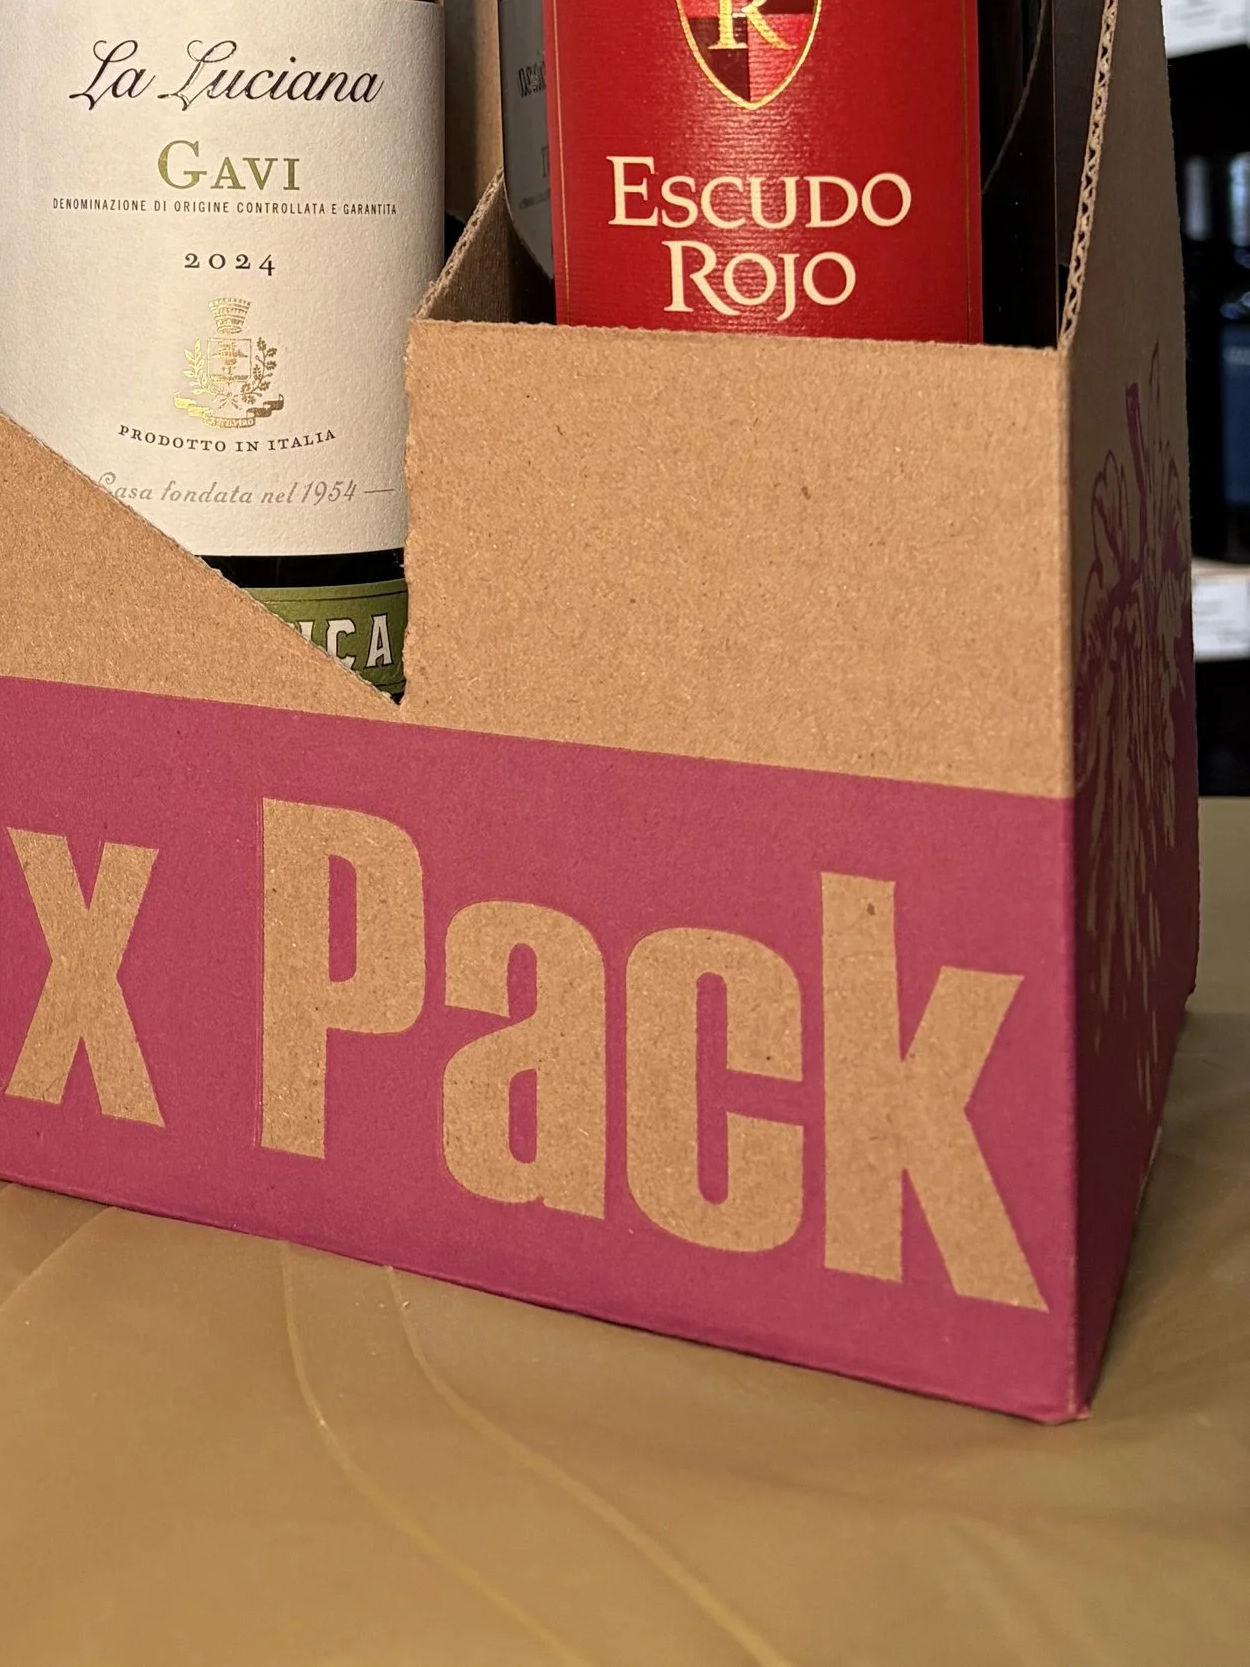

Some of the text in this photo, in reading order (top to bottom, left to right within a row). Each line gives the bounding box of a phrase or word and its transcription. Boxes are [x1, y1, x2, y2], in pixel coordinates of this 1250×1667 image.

[68, 39, 384, 111] La Luciana
[157, 139, 300, 191] GAVI
[53, 197, 398, 215] DENOMINAZIONE DI ORIGINE CONTROLLATA E GARANTITA
[605, 155, 912, 230] ESCUDO
[184, 251, 276, 277] 2024
[661, 239, 857, 322] ROJO
[118, 424, 337, 453] PRODOTTO IN ITALIA
[161, 479, 253, 504] fondata
[261, 481, 296, 505] nel
[300, 479, 357, 506] 1954
[259, 797, 1050, 1313] Pack
